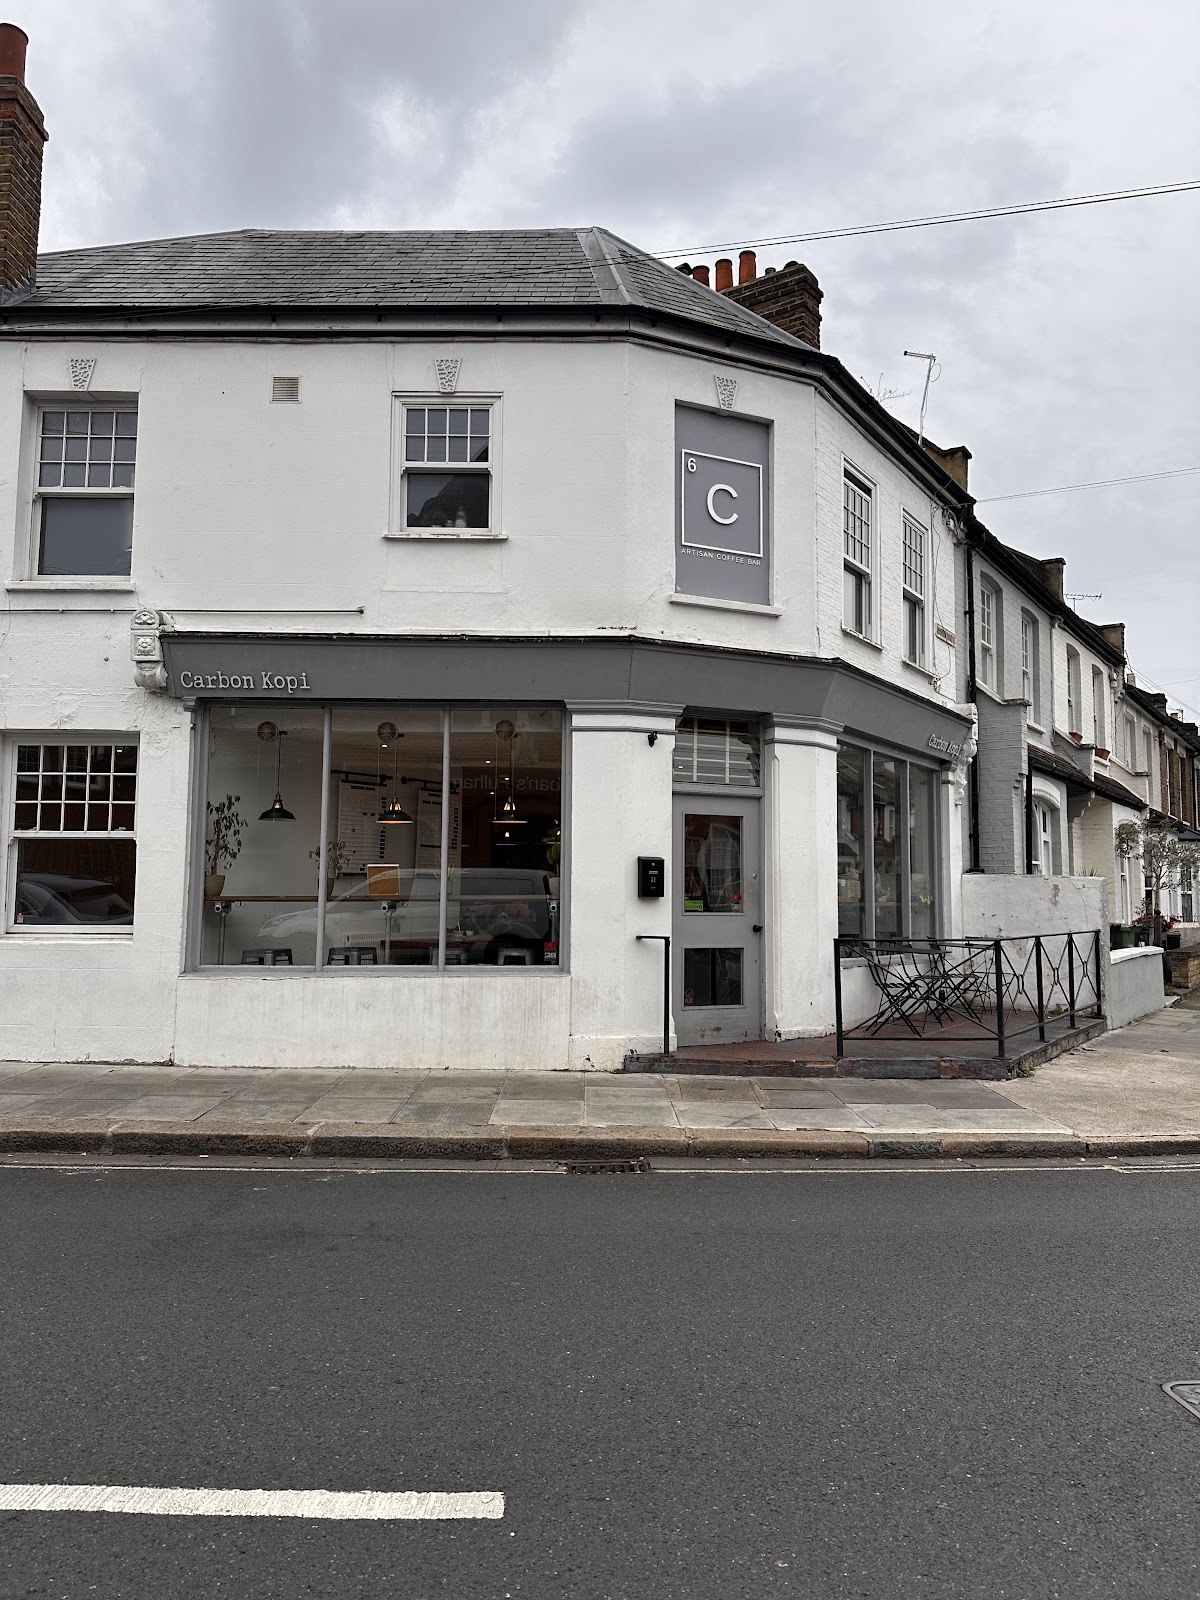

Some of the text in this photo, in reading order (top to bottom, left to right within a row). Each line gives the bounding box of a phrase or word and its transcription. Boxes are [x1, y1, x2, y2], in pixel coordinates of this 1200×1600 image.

[687, 457, 697, 472] 6
[707, 483, 739, 525] C
[681, 547, 761, 566] ARTISAN COFFEE BAR
[180, 670, 311, 693] Carbon Kopi
[928, 733, 949, 752] Carbon
